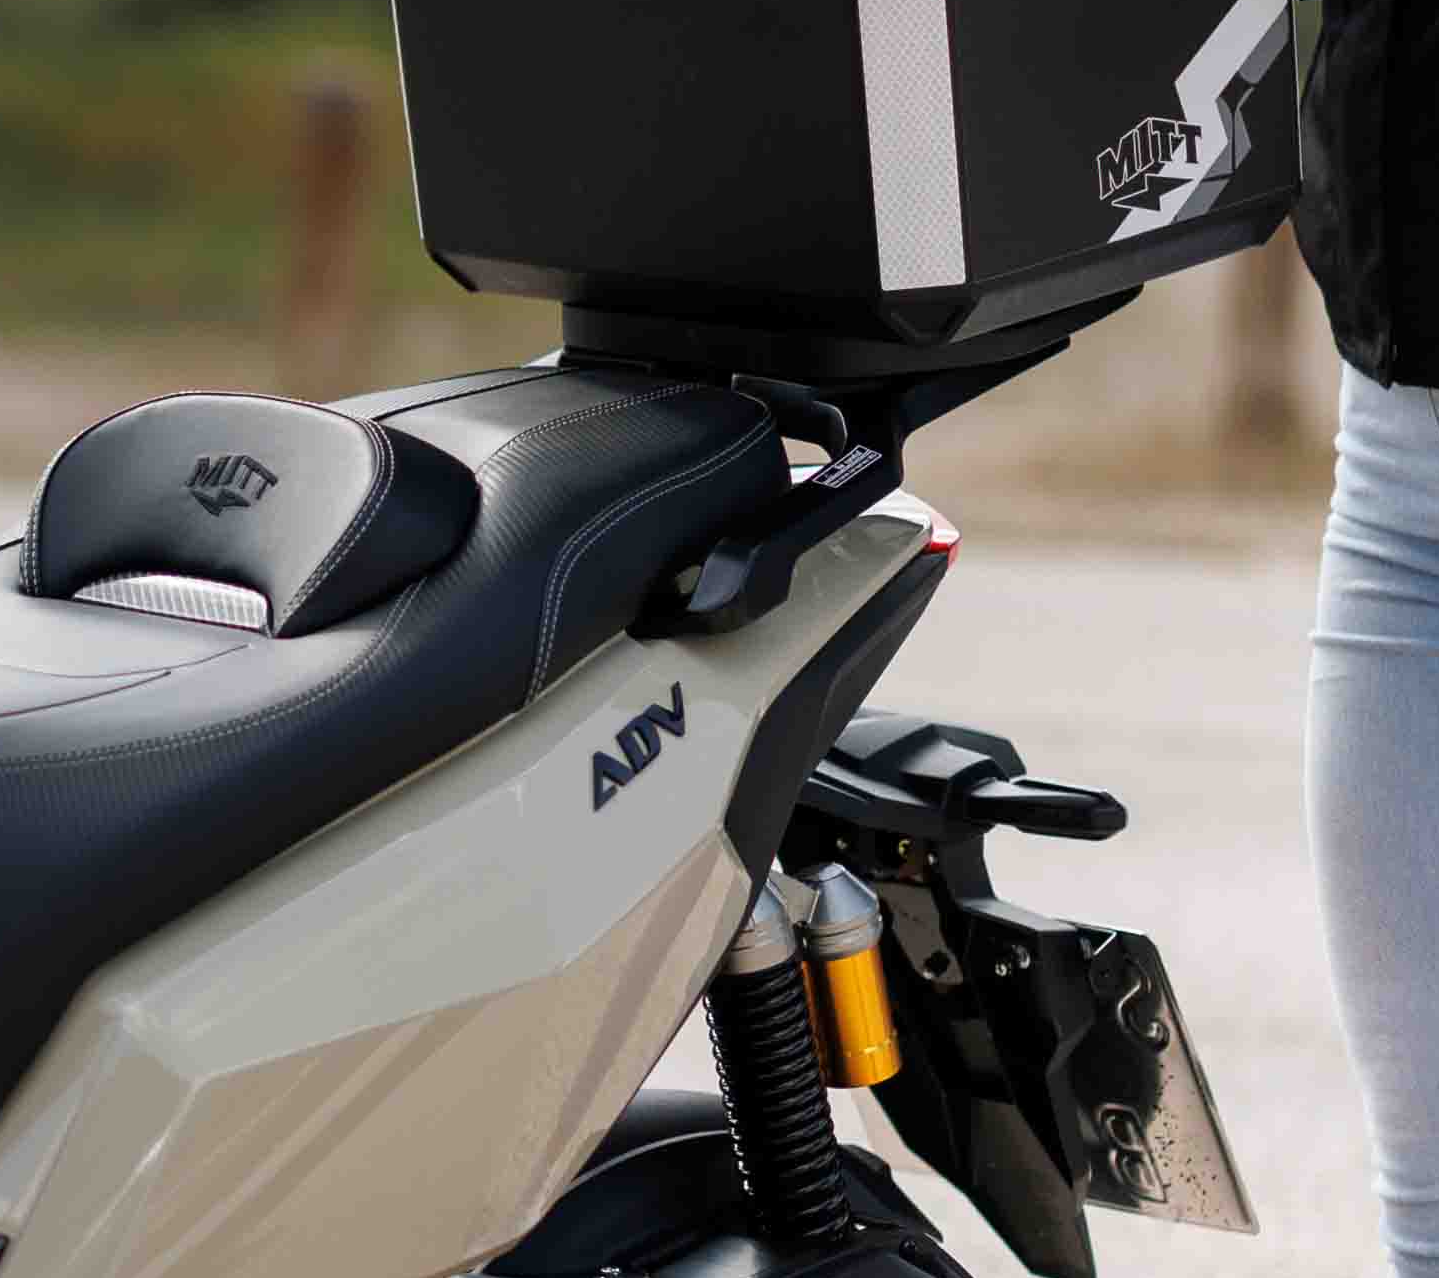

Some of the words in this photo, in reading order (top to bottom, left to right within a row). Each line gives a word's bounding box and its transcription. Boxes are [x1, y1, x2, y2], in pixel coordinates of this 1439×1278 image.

[1096, 117, 1204, 201] MITT
[185, 454, 278, 500] MITT
[593, 680, 686, 813] ADV
